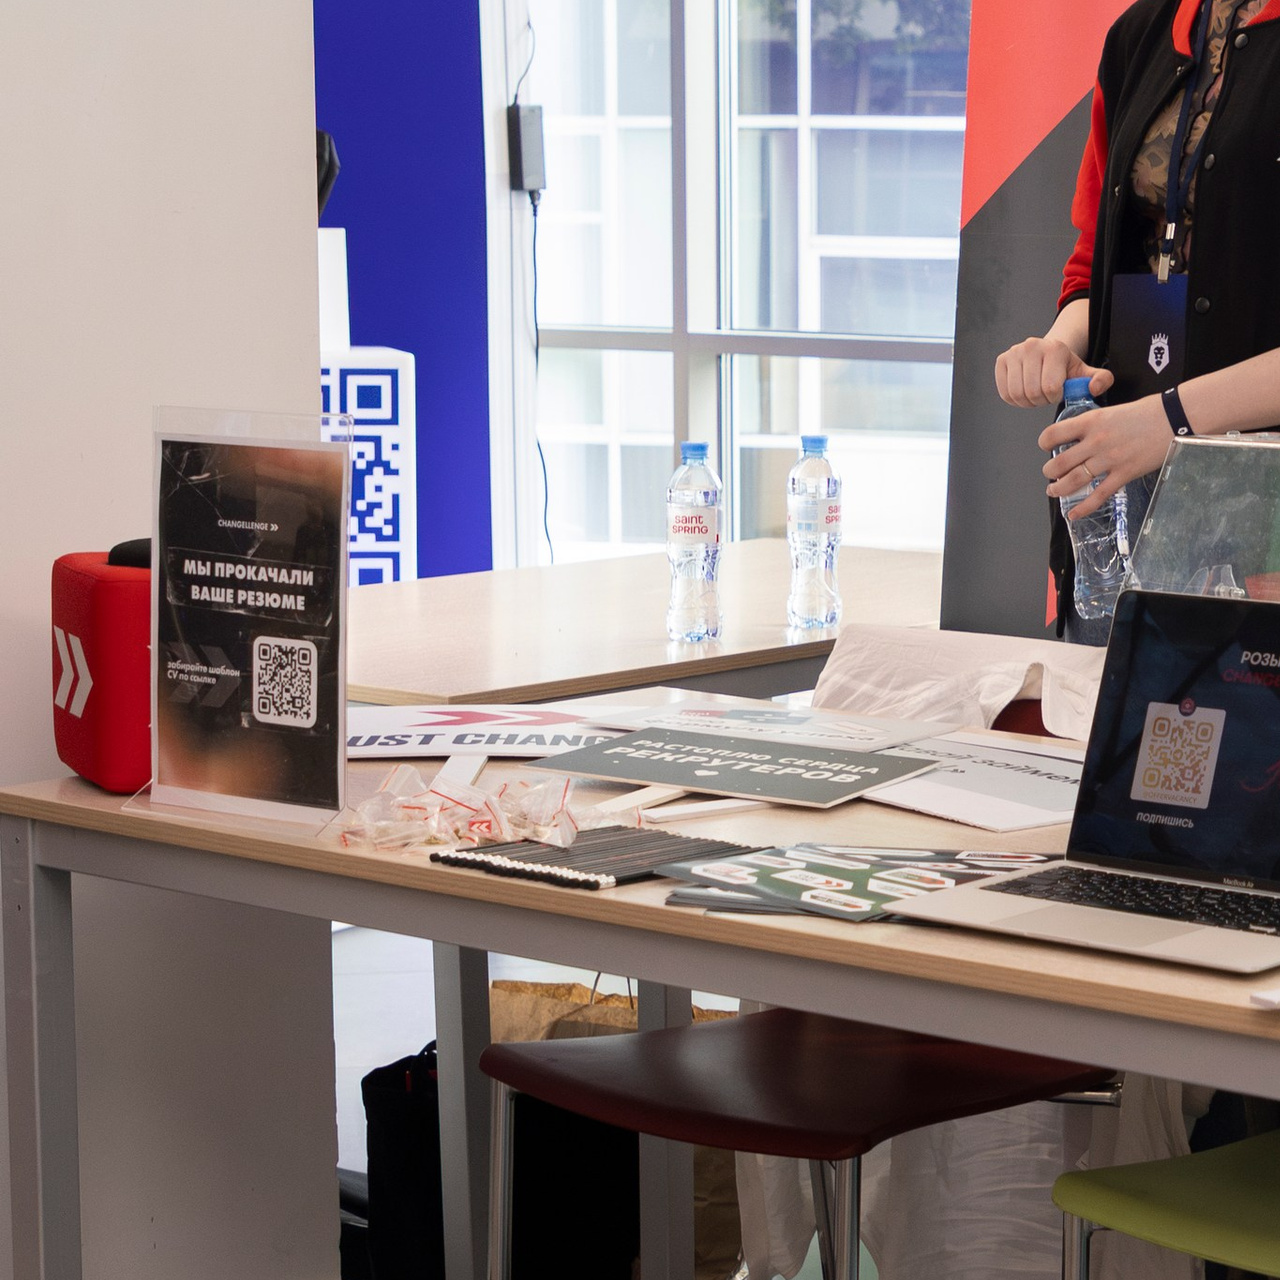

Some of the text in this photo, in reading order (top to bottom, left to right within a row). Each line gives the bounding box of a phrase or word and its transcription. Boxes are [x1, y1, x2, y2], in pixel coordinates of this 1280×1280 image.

[218, 519, 269, 531] CHANGELLENGE
[674, 513, 704, 525] saint
[672, 525, 709, 536] SPRING
[184, 559, 314, 587] МЫ ПРОКАЧАЛИ
[191, 586, 305, 611] ВАШЕ РЕЗЮМЕ
[167, 660, 240, 677] забирайте шаблон
[167, 670, 217, 685] CV по ссылке
[603, 746, 862, 784] РЕКРУТЕРОВ
[632, 739, 880, 775] РАСТОПЛЮ СЕРДЦА
[1136, 812, 1195, 828] ПОДПИШИСЬ
